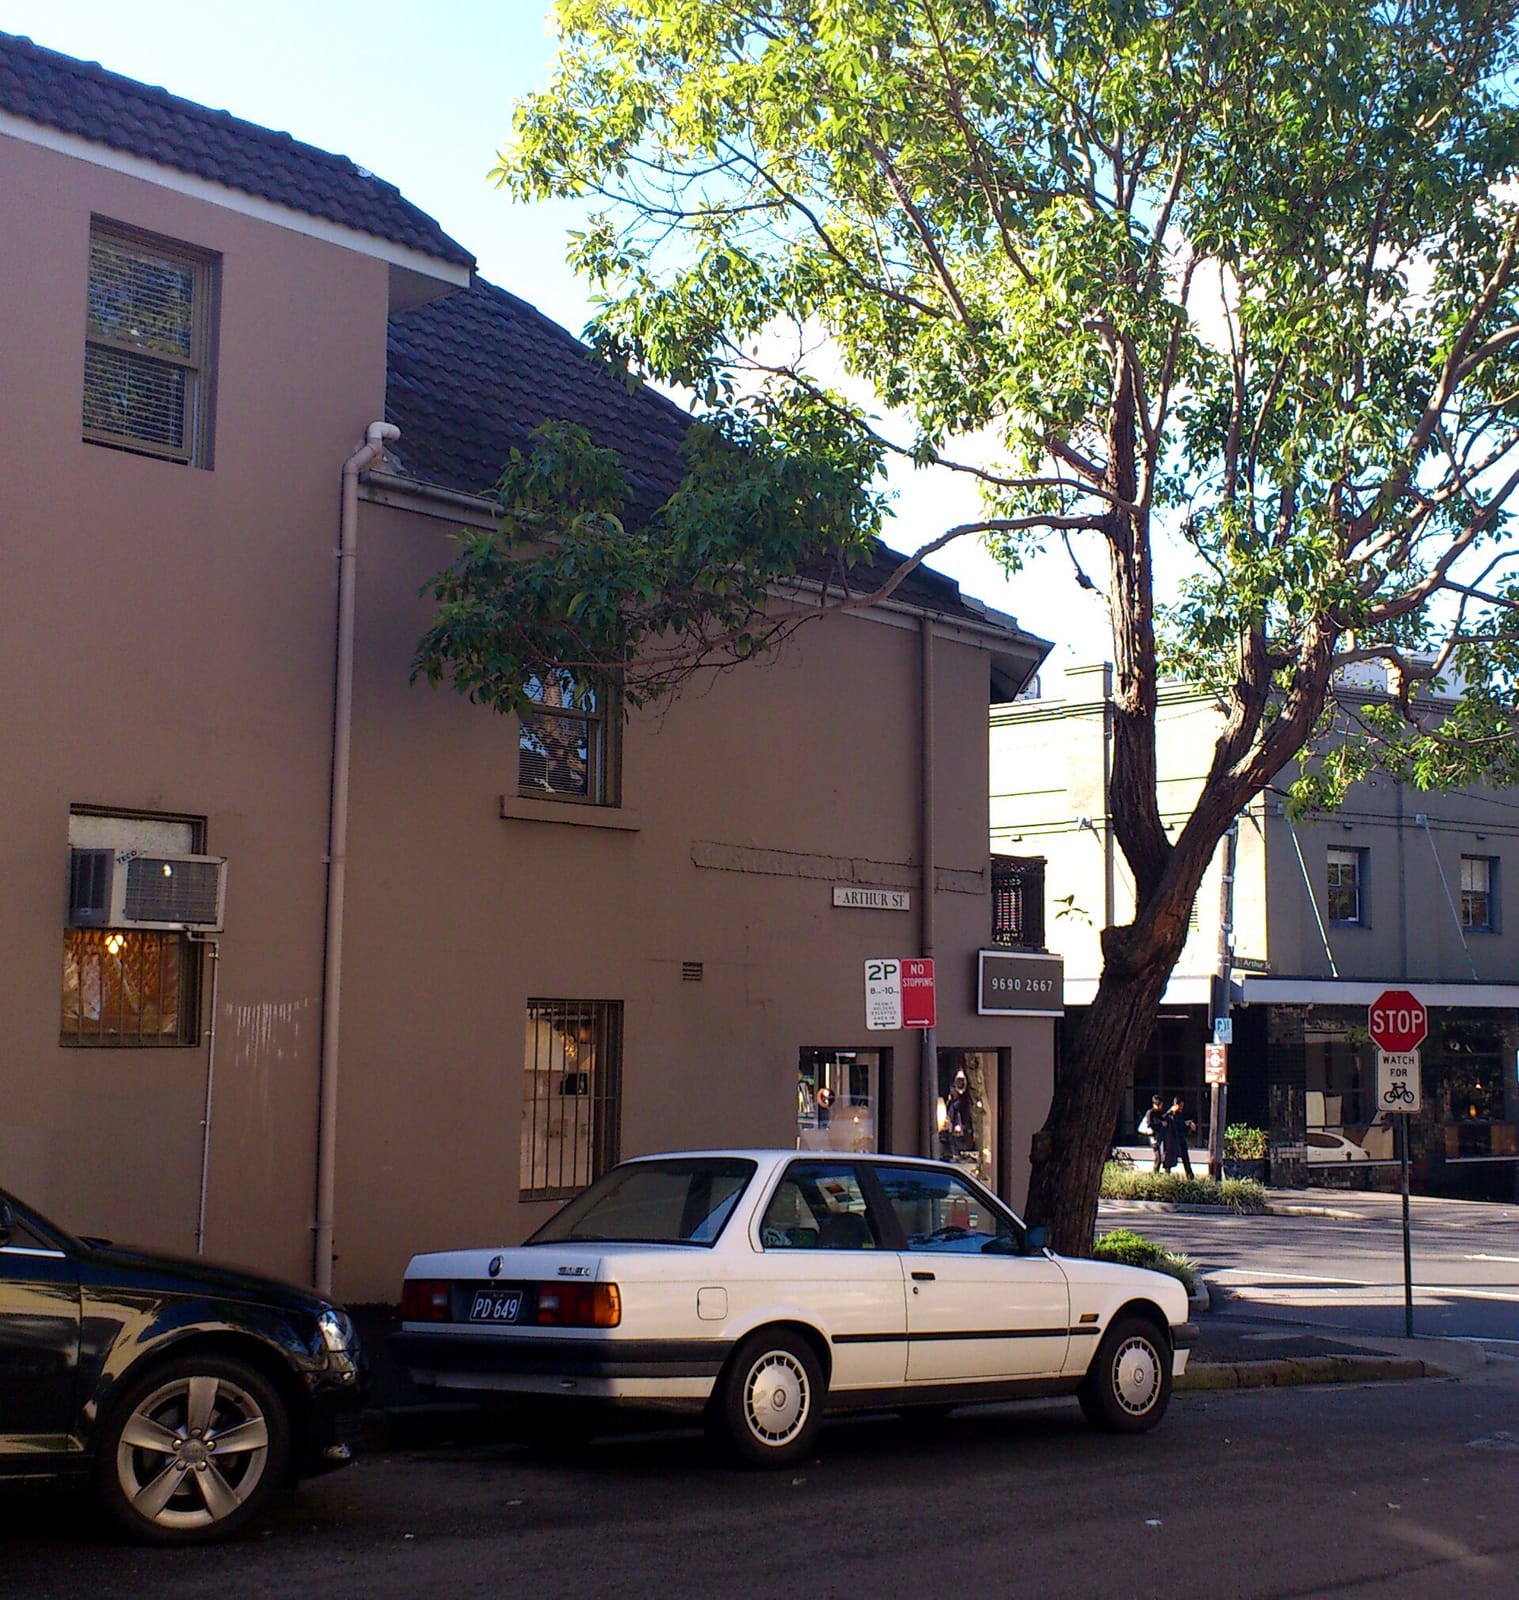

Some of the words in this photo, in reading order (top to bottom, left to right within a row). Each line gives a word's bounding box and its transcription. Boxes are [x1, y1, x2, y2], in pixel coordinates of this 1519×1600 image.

[843, 891, 888, 907] ARTHUR
[892, 894, 905, 907] ST
[868, 964, 897, 981] 2P
[910, 963, 925, 976] NO
[902, 977, 933, 988] STOPPING
[991, 977, 1021, 991] 9690
[1026, 979, 1053, 992] 2667
[1372, 1009, 1424, 1034] STOP
[1383, 1055, 1415, 1065] WATCH
[1389, 1068, 1408, 1077] FOR
